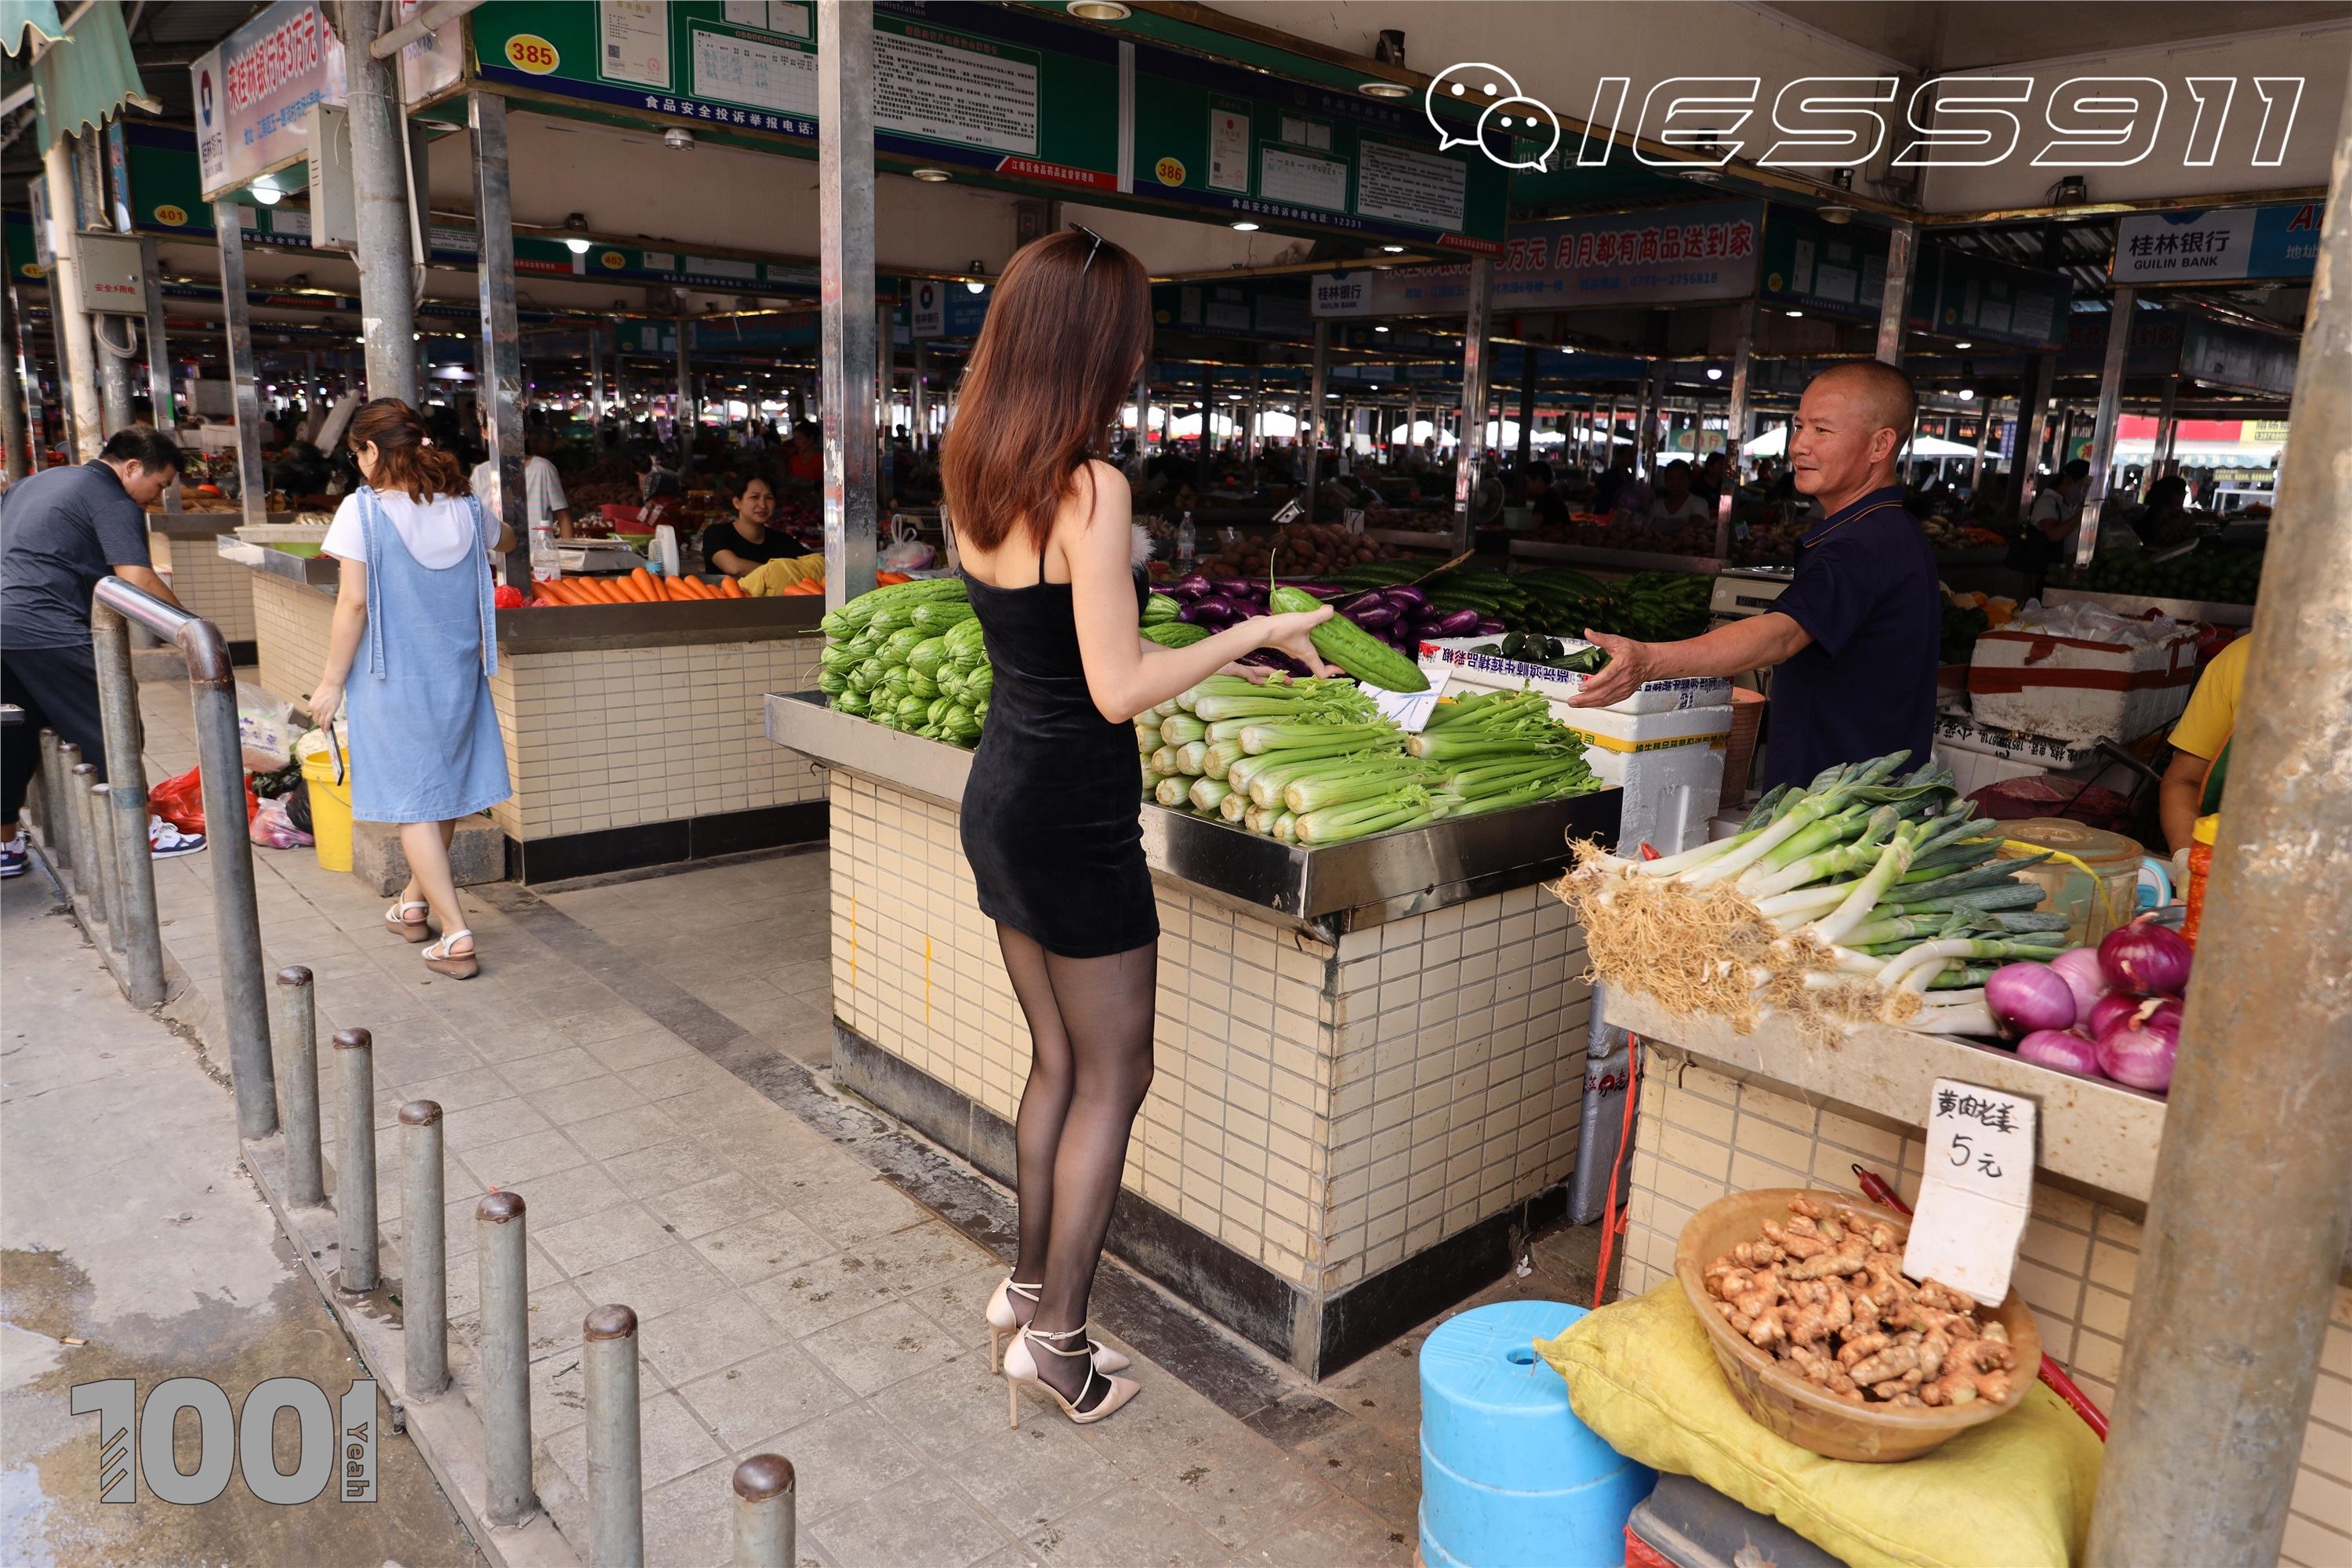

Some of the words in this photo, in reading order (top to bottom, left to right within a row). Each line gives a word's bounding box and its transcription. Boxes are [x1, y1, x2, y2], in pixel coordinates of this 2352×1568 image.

[512, 42, 553, 66] 385
[1011, 161, 1094, 183] 江南区食品药品监督管理局
[1160, 162, 1182, 182] 386
[159, 210, 183, 222] 401
[1334, 216, 1362, 229] 12331
[1555, 220, 1753, 267] 月月都有商品送到家
[2129, 230, 2230, 257] 桂林银行
[604, 255, 622, 267] 402
[2134, 259, 2176, 270] GUILIN
[2182, 256, 2218, 267] BANK
[95, 283, 136, 295] 安全用电
[1318, 285, 1362, 300] 桂林银行
[1950, 1133, 2003, 1178] 5元
